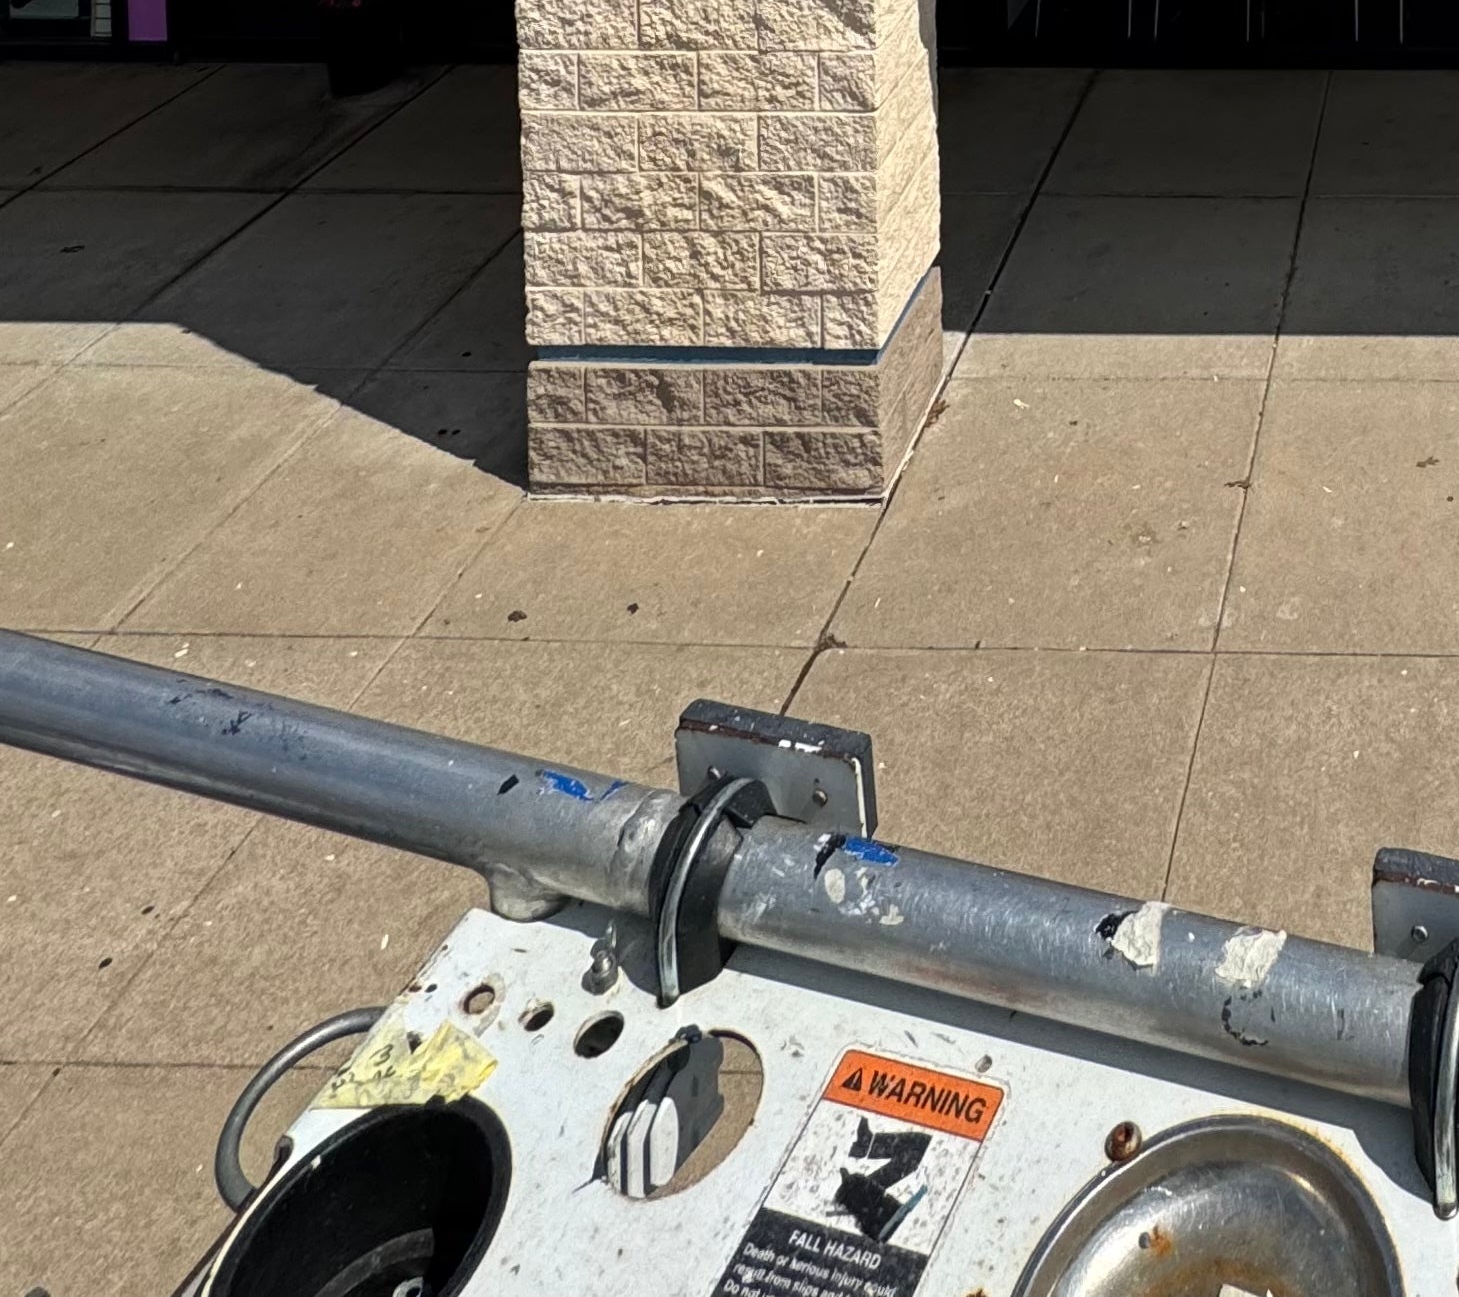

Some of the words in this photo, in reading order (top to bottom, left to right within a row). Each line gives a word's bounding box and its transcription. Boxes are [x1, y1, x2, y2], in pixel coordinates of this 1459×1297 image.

[868, 1069, 988, 1125] WARNING
[742, 1242, 776, 1263] Death
[775, 1254, 790, 1268] or
[831, 1267, 864, 1292] injury
[788, 1229, 821, 1253] FALL
[823, 1240, 882, 1270] HAZARD
[723, 1278, 740, 1295] Do
[765, 1269, 792, 1290] from
